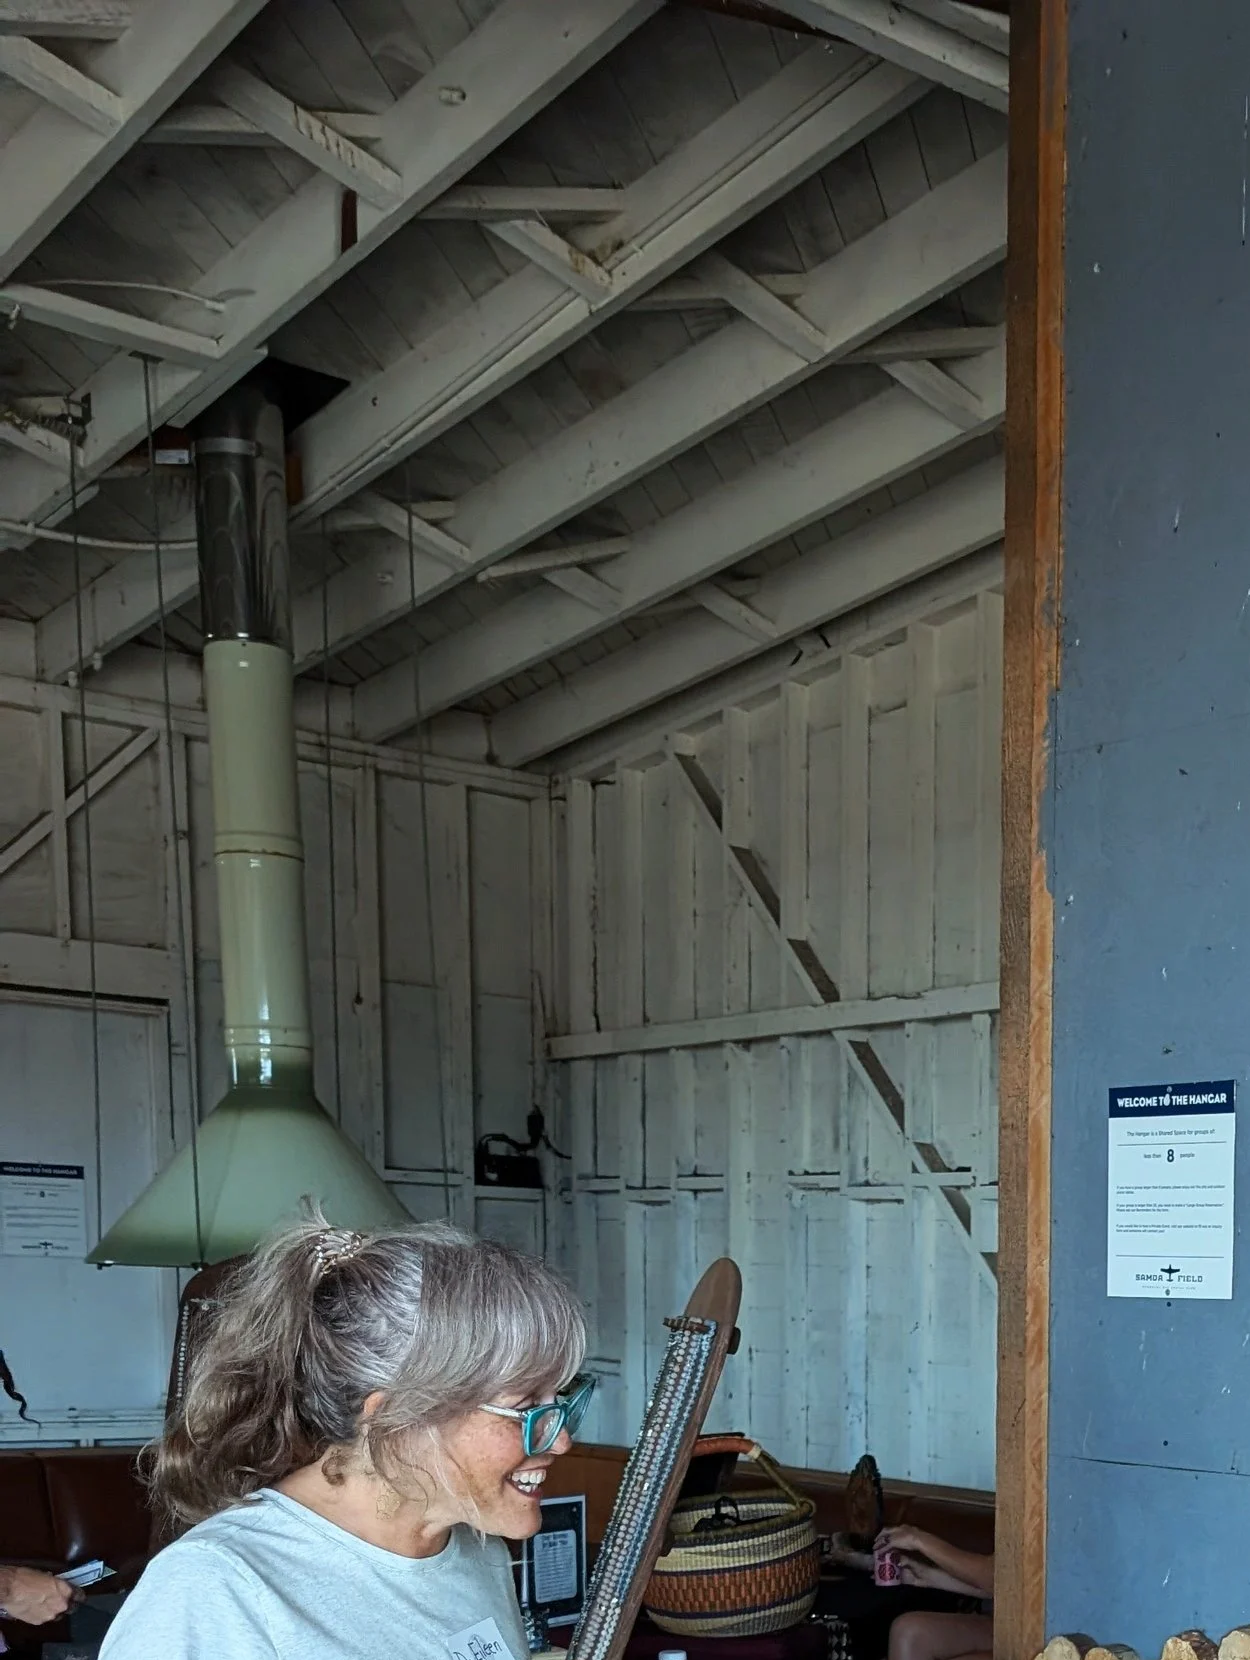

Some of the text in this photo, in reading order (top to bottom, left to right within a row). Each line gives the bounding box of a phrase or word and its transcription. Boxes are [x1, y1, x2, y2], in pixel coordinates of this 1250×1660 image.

[1117, 1096, 1158, 1108] WELCOME
[1171, 1095, 1188, 1106] THE
[1189, 1093, 1227, 1105] HANGAR
[1166, 1149, 1175, 1163] 8
[1177, 1275, 1203, 1283] FIELD
